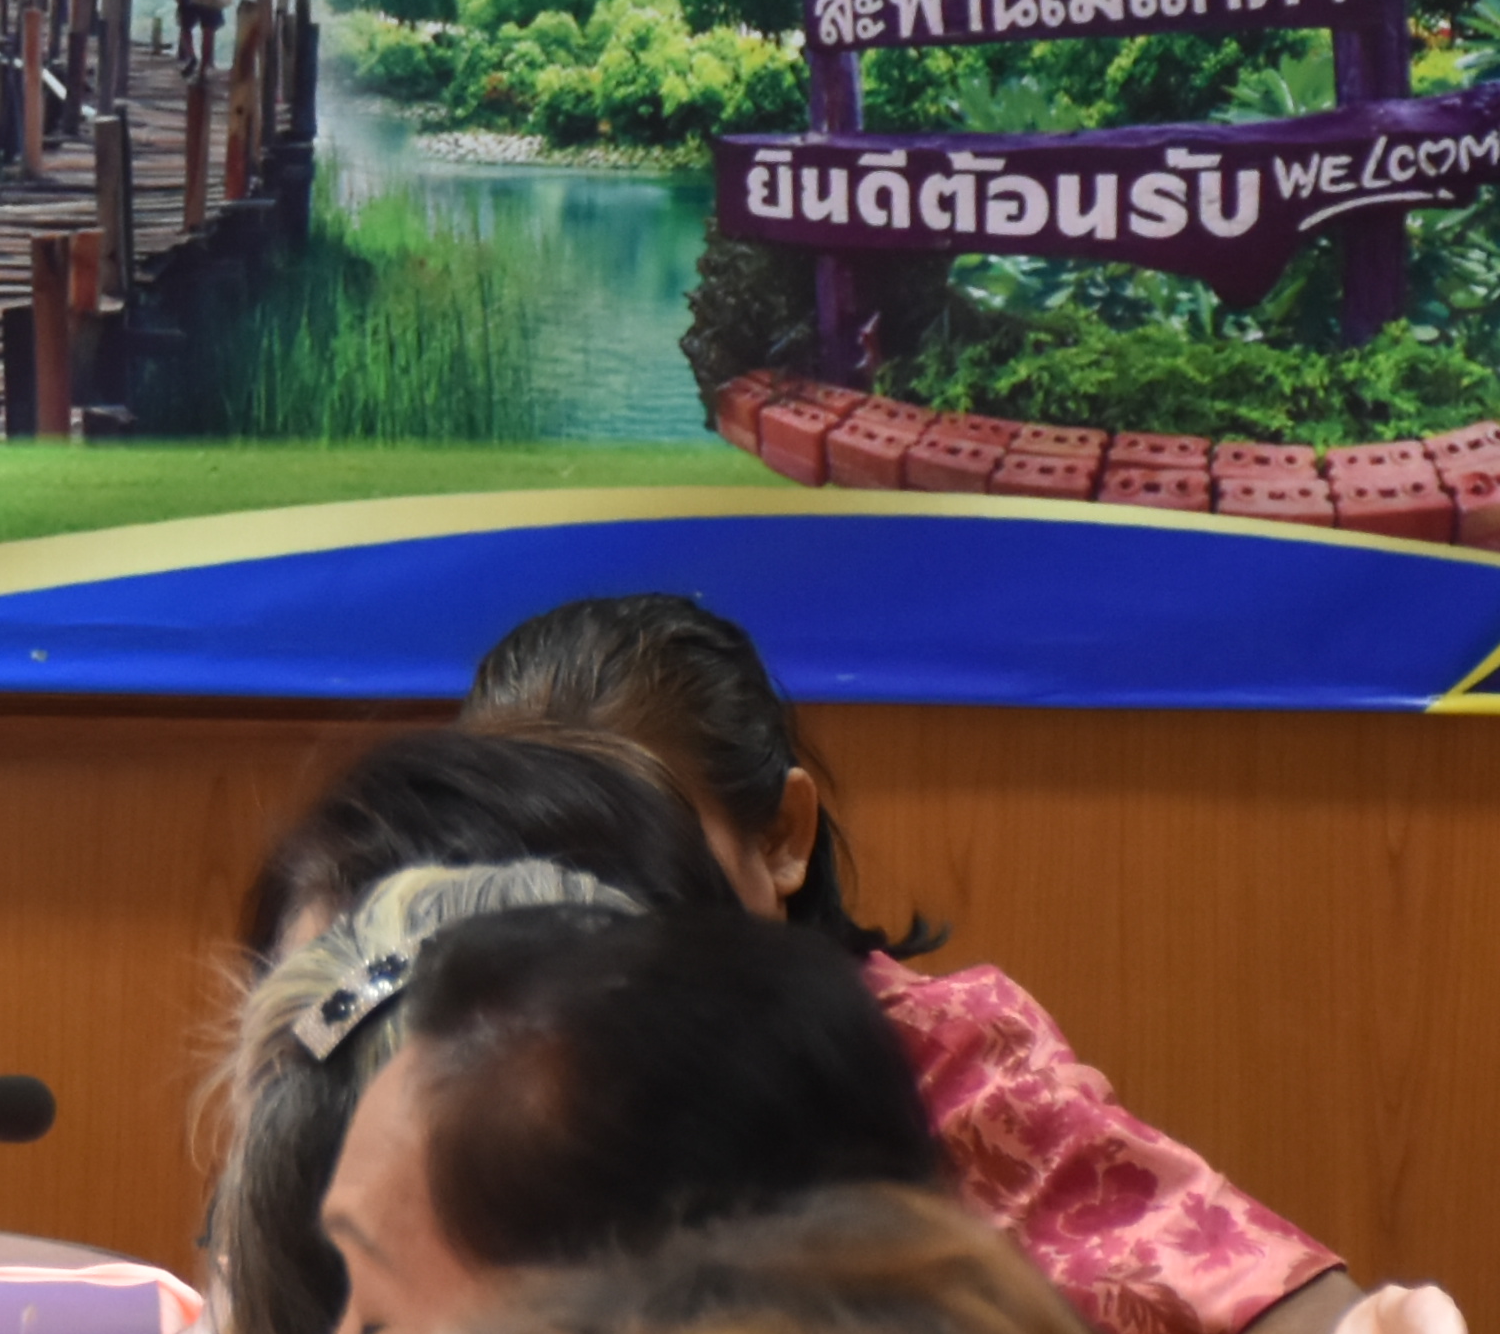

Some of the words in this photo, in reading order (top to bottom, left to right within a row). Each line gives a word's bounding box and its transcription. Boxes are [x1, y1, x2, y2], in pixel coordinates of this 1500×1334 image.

[745, 148, 1261, 240] ยินดีต้อนรับ
